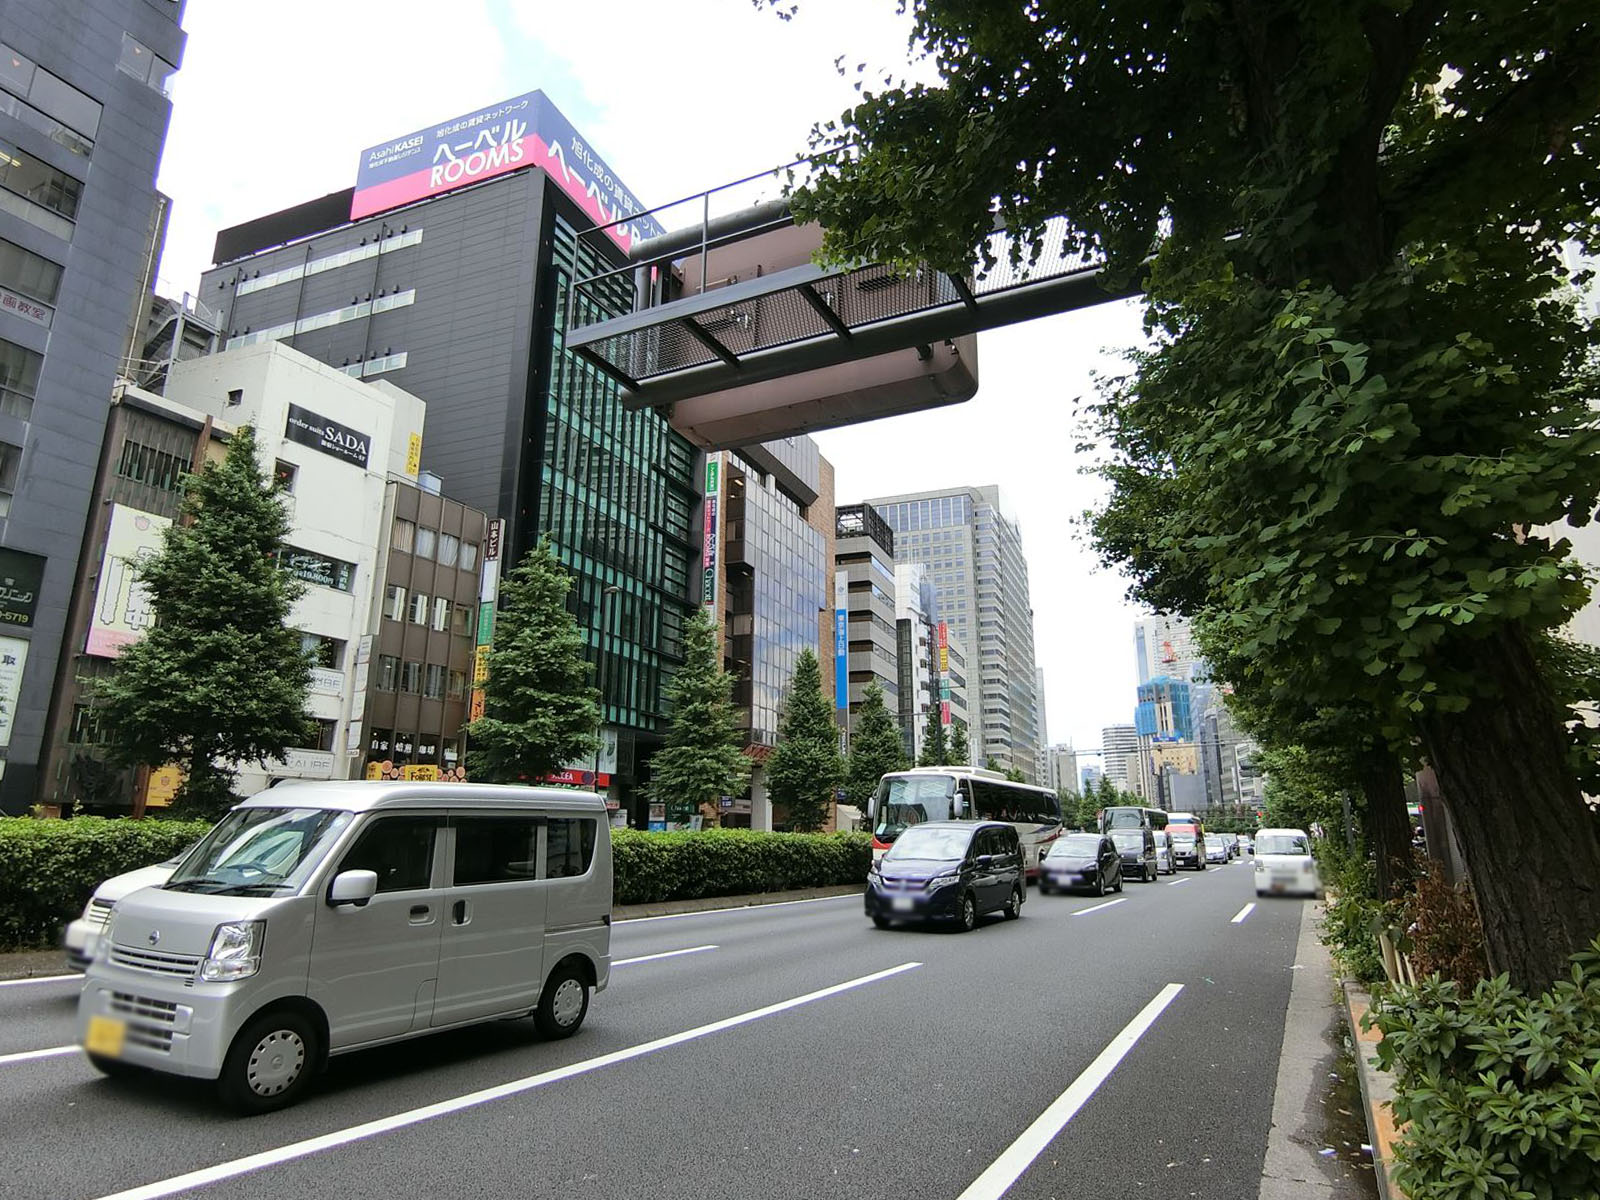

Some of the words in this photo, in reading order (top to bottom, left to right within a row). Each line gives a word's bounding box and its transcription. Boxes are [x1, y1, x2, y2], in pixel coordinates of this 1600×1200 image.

[436, 100, 528, 138] 旭化成の賃貸ネットワーク
[430, 136, 524, 188] ROOMS
[432, 118, 527, 164] ヘーベル
[548, 139, 628, 236] ヘーベル
[289, 417, 309, 429] order
[325, 426, 367, 455] SADA
[489, 521, 499, 556] 山本ビル
